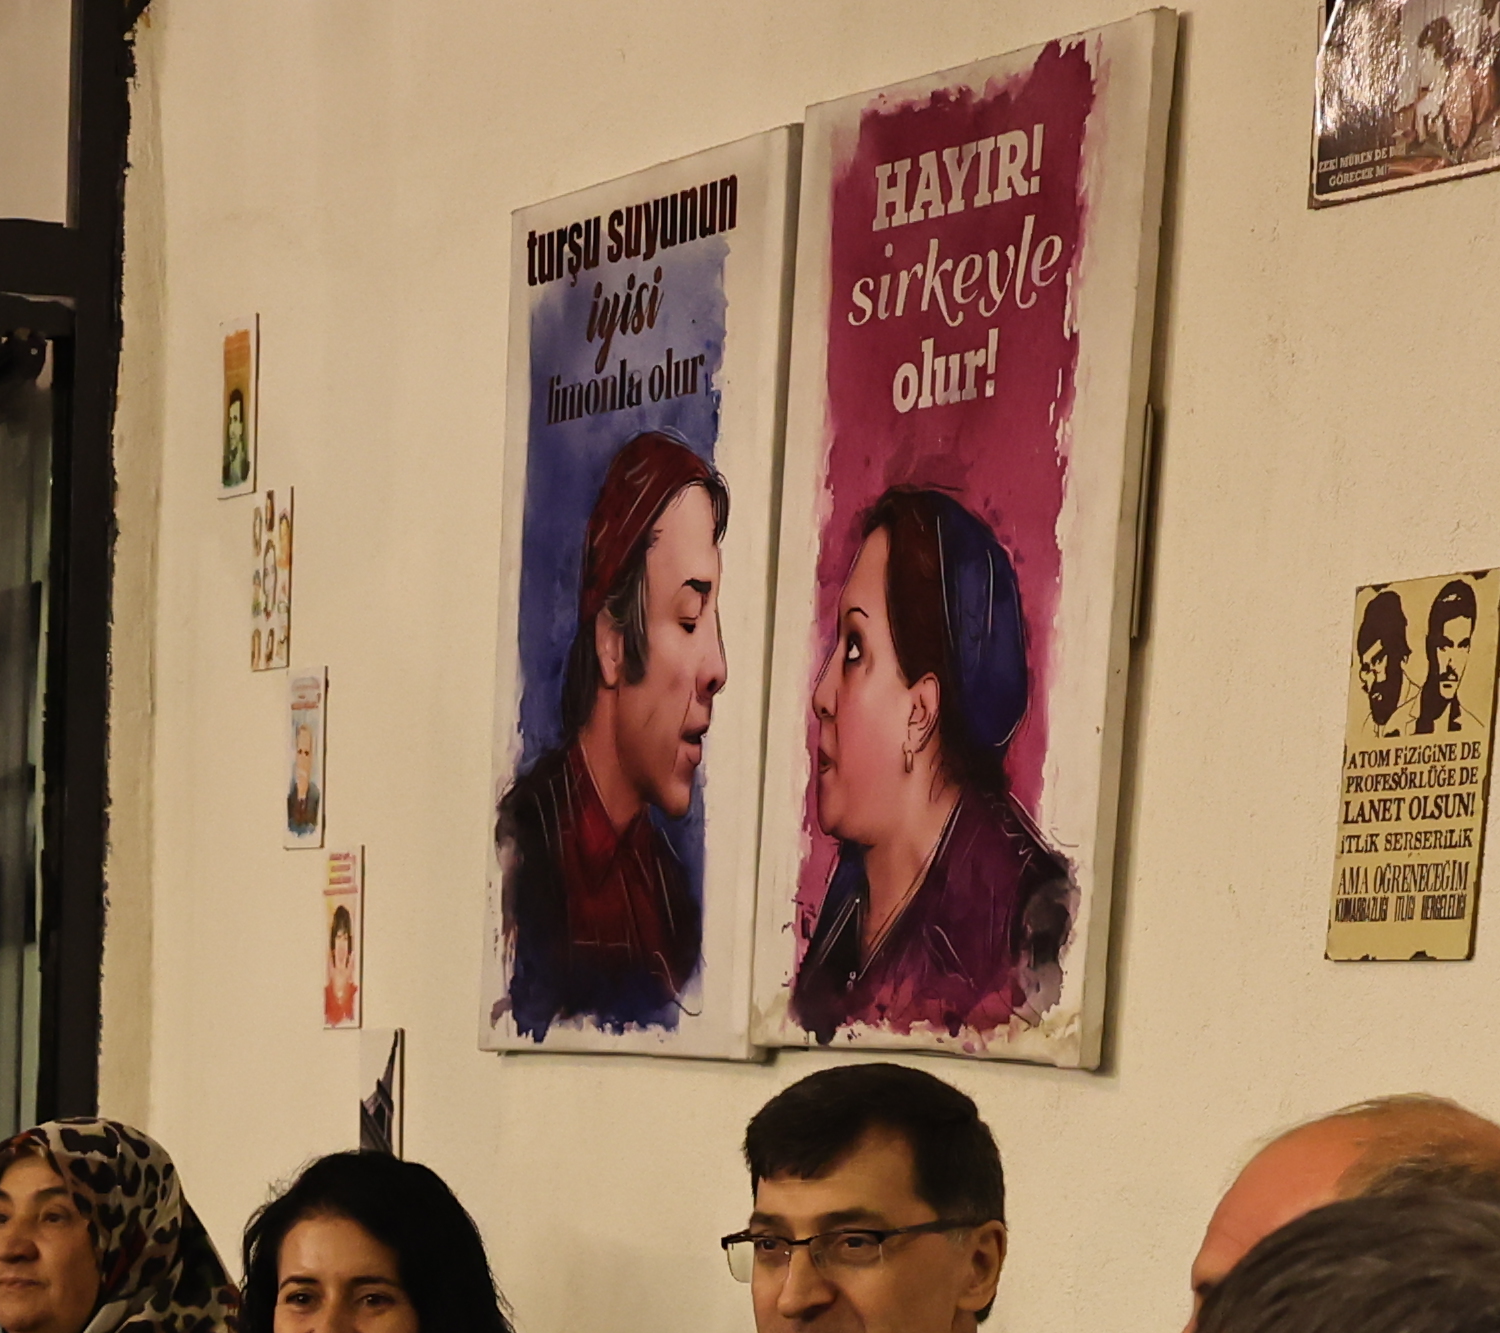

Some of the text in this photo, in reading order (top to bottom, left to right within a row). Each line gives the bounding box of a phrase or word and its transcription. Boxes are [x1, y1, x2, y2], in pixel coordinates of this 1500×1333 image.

[872, 123, 1044, 232] HAYIR!
[527, 174, 738, 287] turşu suyunun
[847, 214, 1062, 327] sirkeyle
[586, 266, 664, 374] iyisi
[547, 347, 705, 425] limonla olur
[893, 327, 999, 414] olur!
[1345, 765, 1479, 794] PROFESÖRLÜĞE DE
[1347, 748, 1391, 769] ATOM
[1459, 741, 1481, 760] DE
[1342, 791, 1476, 825] LANET OLSUN!
[1337, 866, 1369, 896] AMA
